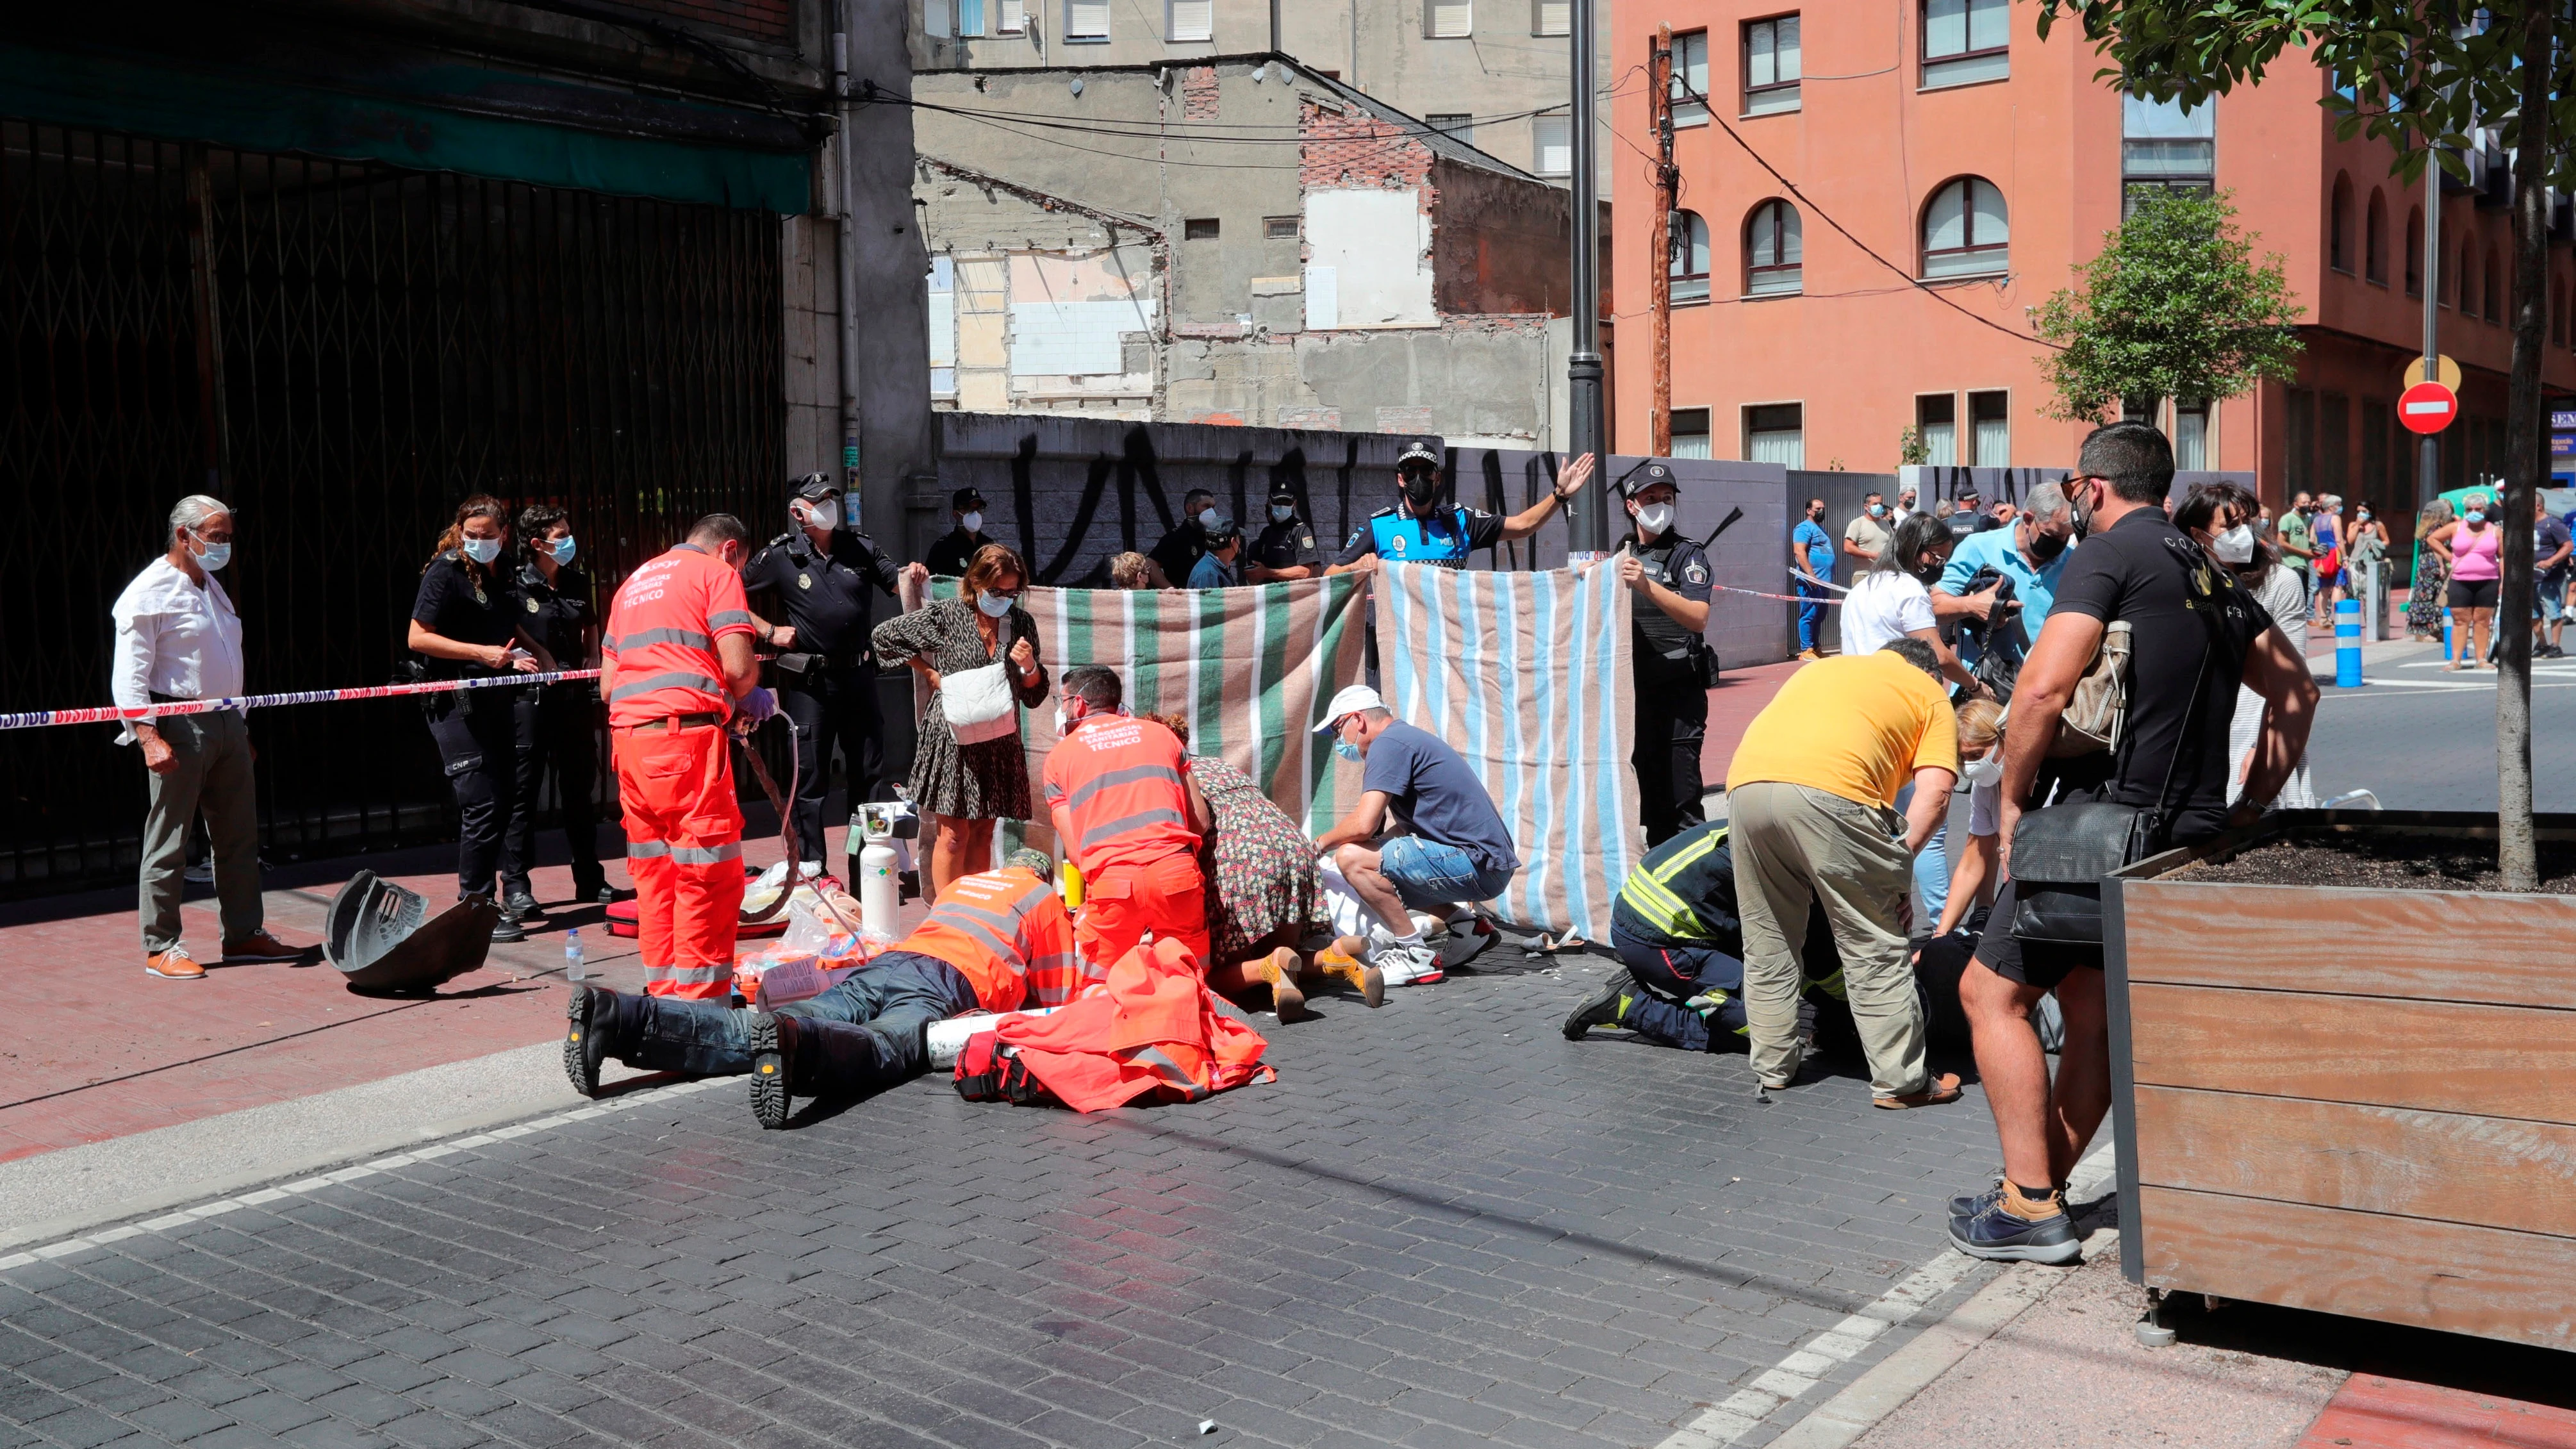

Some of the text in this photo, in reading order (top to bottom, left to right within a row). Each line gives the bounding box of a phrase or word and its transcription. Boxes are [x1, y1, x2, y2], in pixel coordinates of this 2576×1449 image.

[1078, 724, 1143, 742] EMERGENCIAS
[1086, 729, 1139, 745] SANITARIAS
[452, 760, 468, 770] CNP
